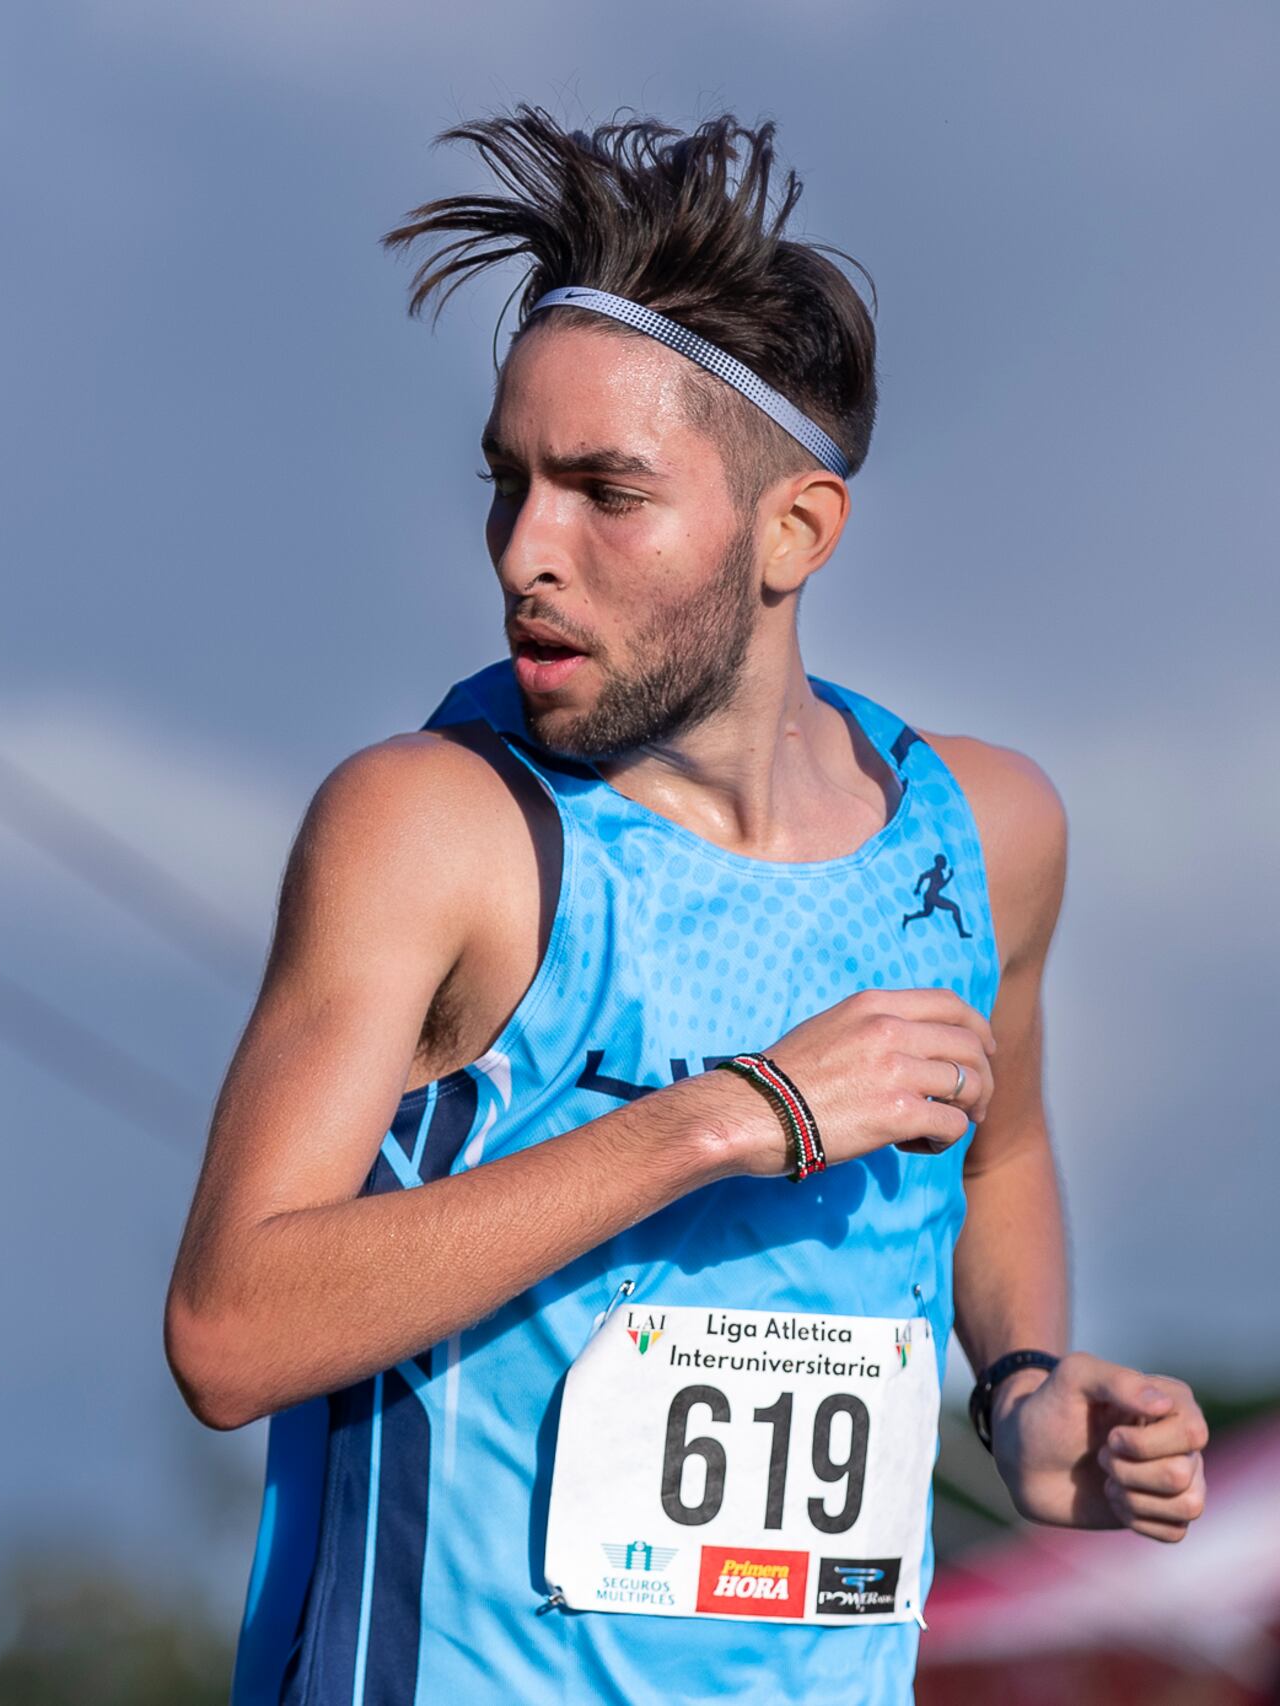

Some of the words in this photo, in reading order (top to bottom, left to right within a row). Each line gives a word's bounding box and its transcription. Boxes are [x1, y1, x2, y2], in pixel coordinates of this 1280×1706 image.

[705, 1313, 757, 1339] Liga
[764, 1318, 853, 1344] Atletica
[669, 1346, 881, 1378] Interuniversitaria
[660, 1384, 870, 1534] 619
[721, 1559, 790, 1578] Primera
[596, 1589, 675, 1606] MULTIPLES
[602, 1576, 671, 1593] SEGUROS
[713, 1575, 790, 1601] HORA
